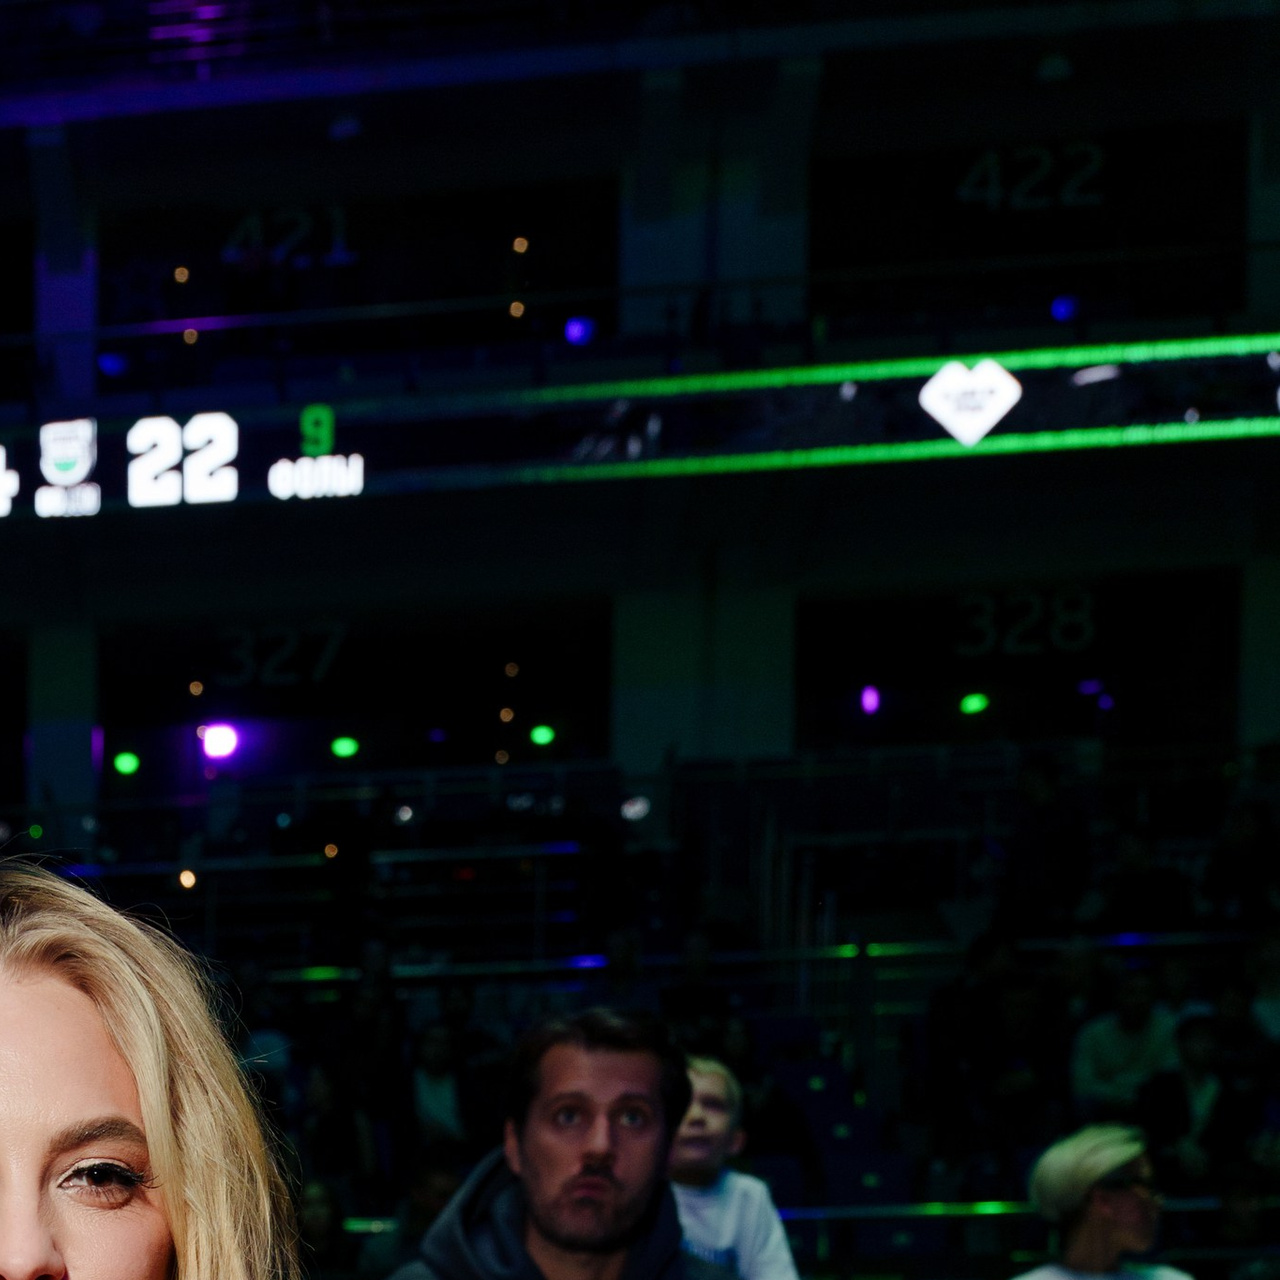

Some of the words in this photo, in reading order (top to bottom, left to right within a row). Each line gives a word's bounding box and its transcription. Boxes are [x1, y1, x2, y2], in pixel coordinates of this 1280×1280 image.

[954, 144, 1108, 213] 422
[220, 206, 359, 272] 421
[126, 412, 239, 508] 22
[299, 403, 335, 457] 9
[217, 622, 347, 689] 327
[953, 589, 1097, 657] 328
